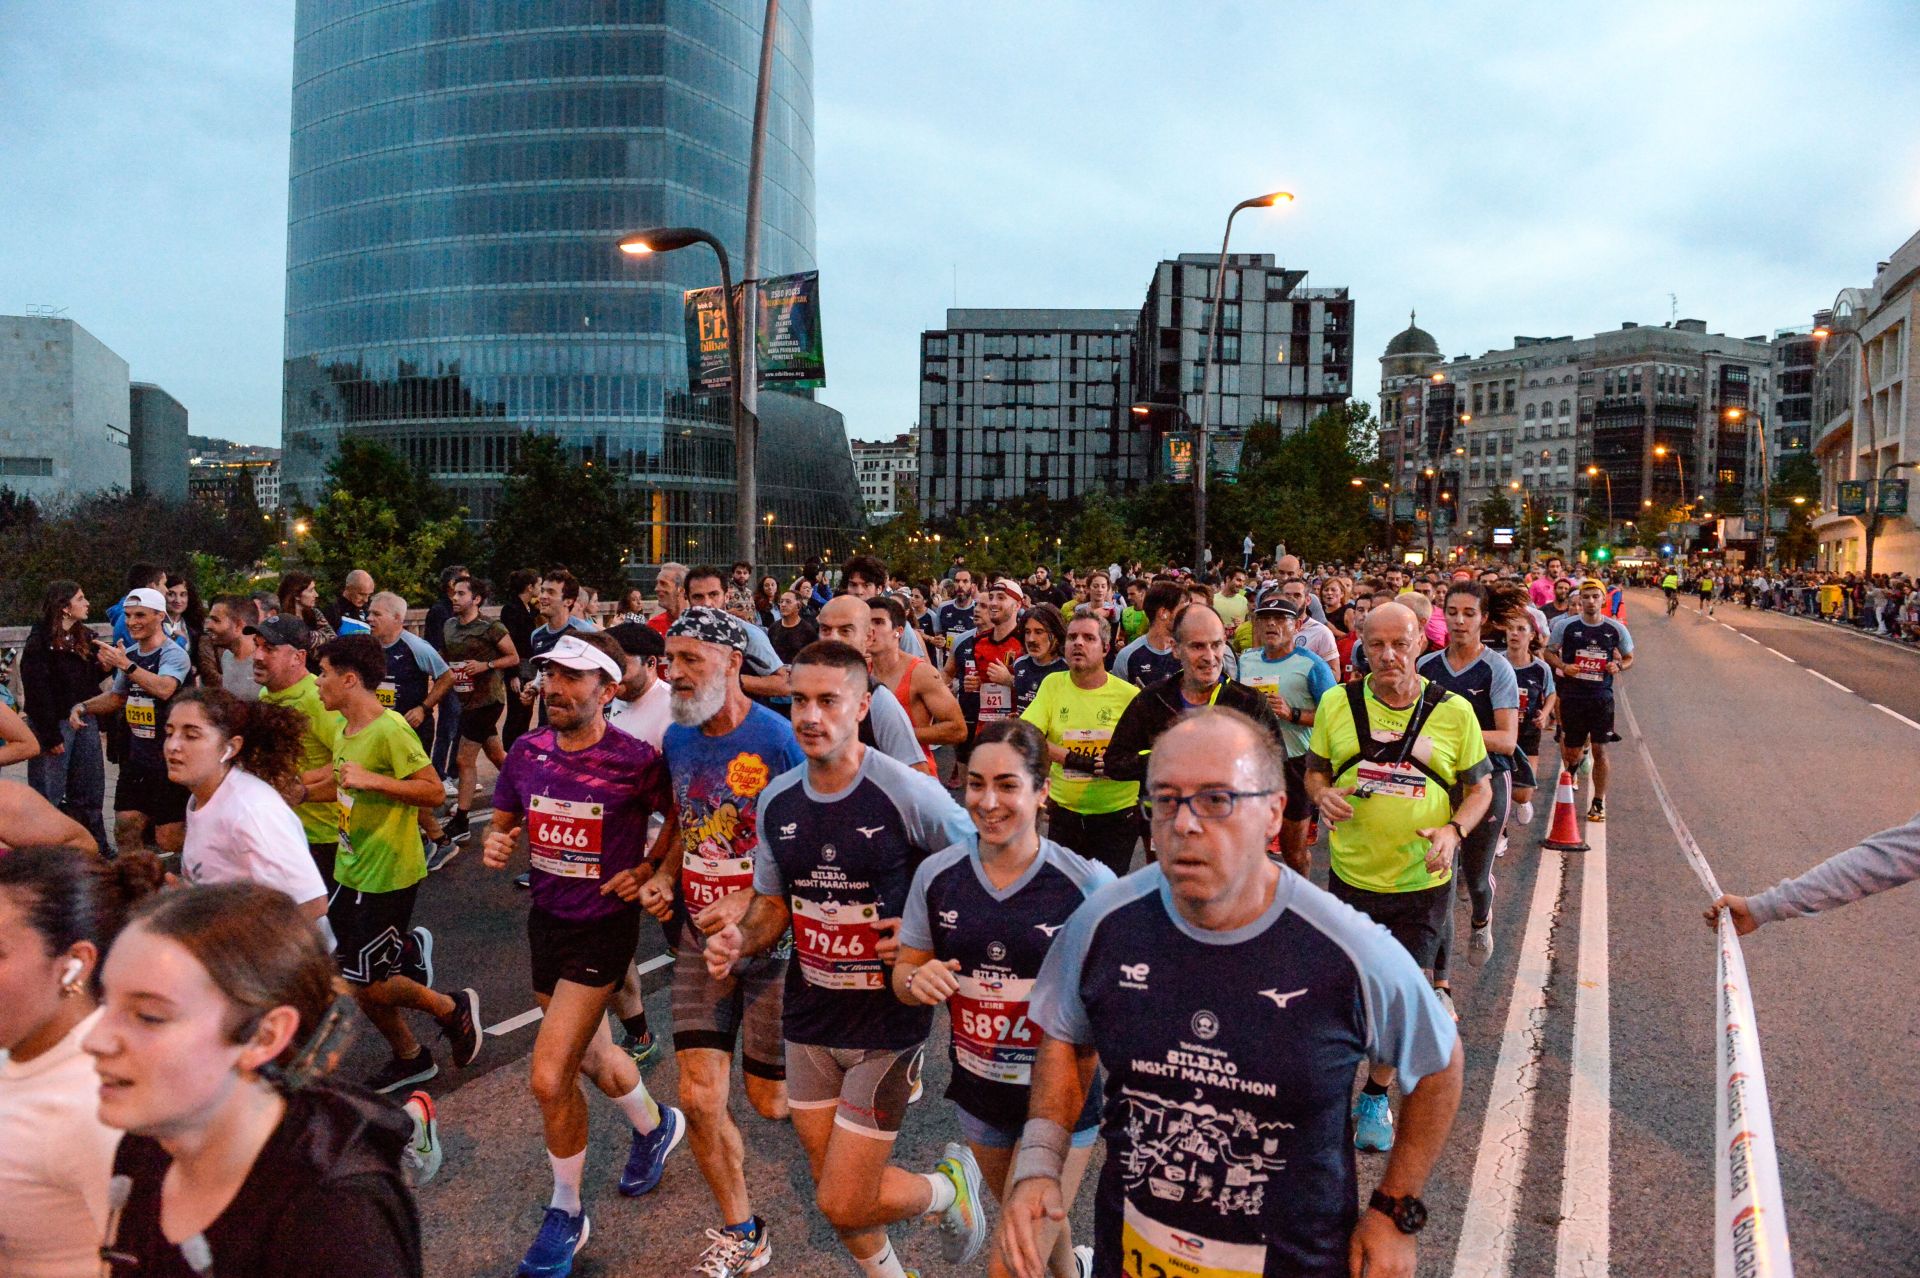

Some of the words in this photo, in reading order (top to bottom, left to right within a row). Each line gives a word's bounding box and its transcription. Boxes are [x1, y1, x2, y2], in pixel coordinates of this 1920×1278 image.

[986, 696, 1003, 705] 621
[538, 823, 589, 848] 6666
[811, 870, 847, 881] BILBAO
[819, 880, 870, 890] MARATHON
[804, 927, 865, 957] 7946
[979, 1001, 1005, 1010] LEIRE
[961, 1008, 1031, 1042] 5894
[1166, 1050, 1238, 1076] BILBAO
[1131, 1059, 1179, 1079] NIGHT
[1181, 1068, 1277, 1098] MARATHON
